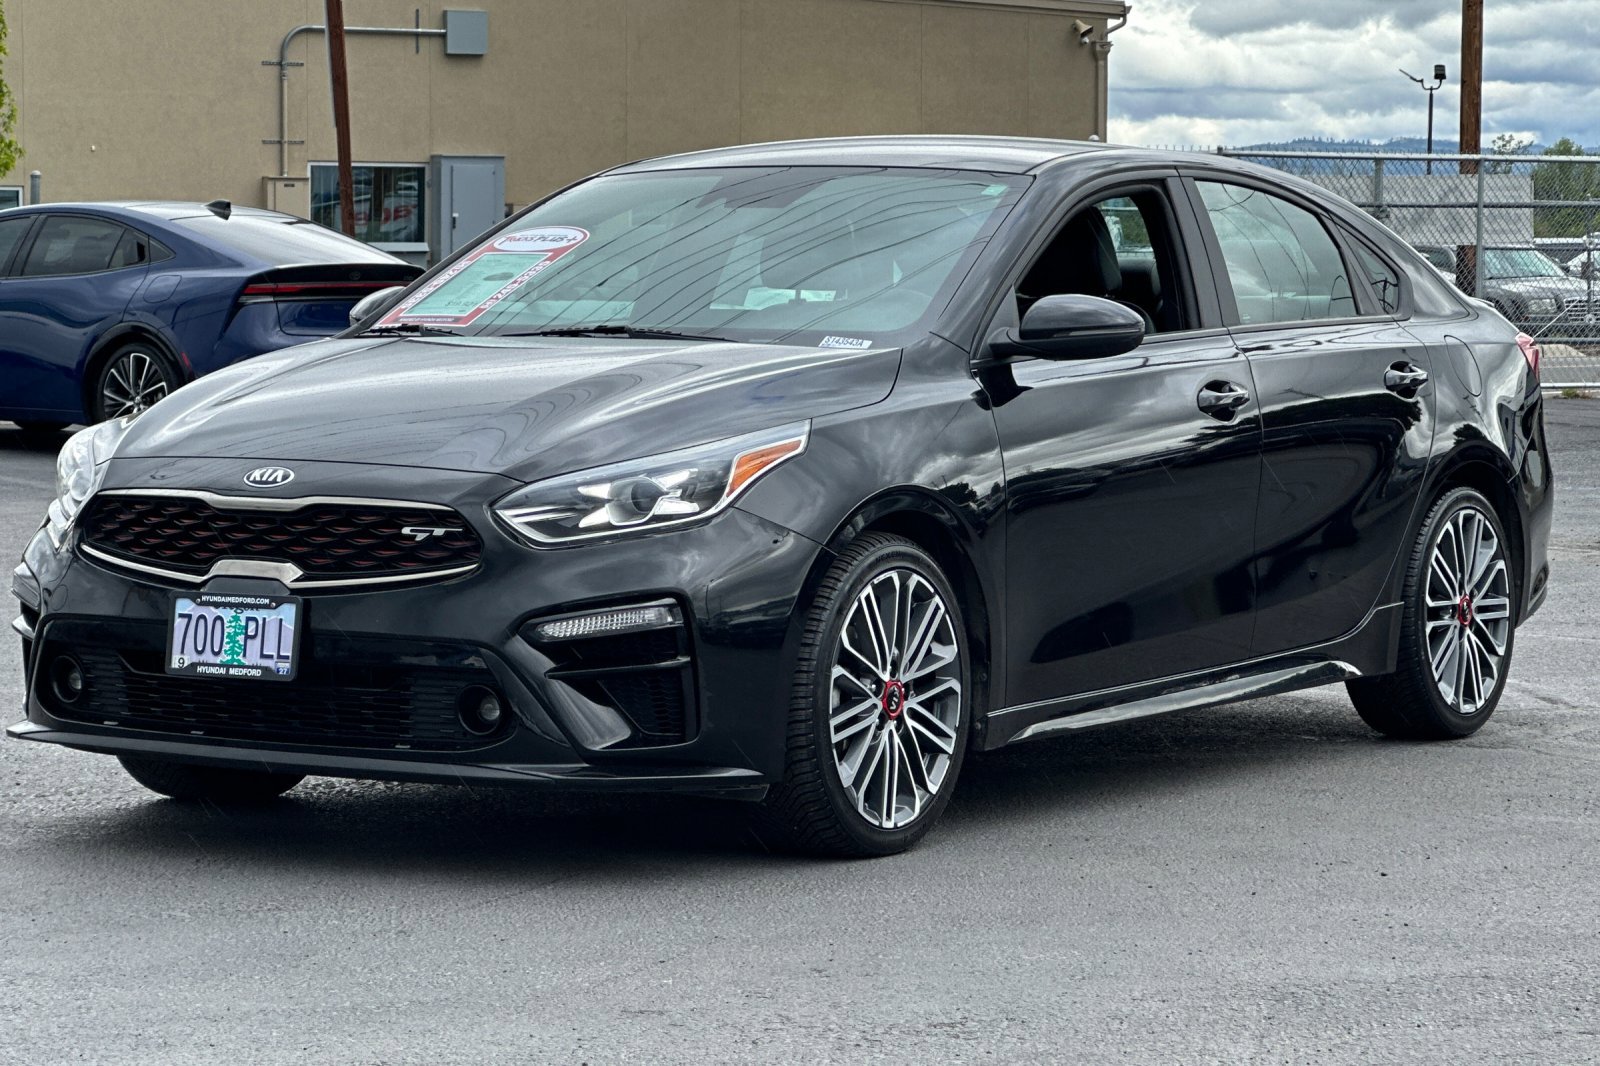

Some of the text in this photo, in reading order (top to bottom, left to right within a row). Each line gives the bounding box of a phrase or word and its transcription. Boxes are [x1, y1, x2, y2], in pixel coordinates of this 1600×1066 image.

[249, 468, 284, 484] KIA
[401, 526, 464, 541] GT
[201, 595, 270, 605] HYUNDAIMEDFORD.COM
[178, 613, 290, 660] 700 PLL
[177, 657, 185, 669] 9
[196, 665, 262, 677] HYUNDAI MEDFORD
